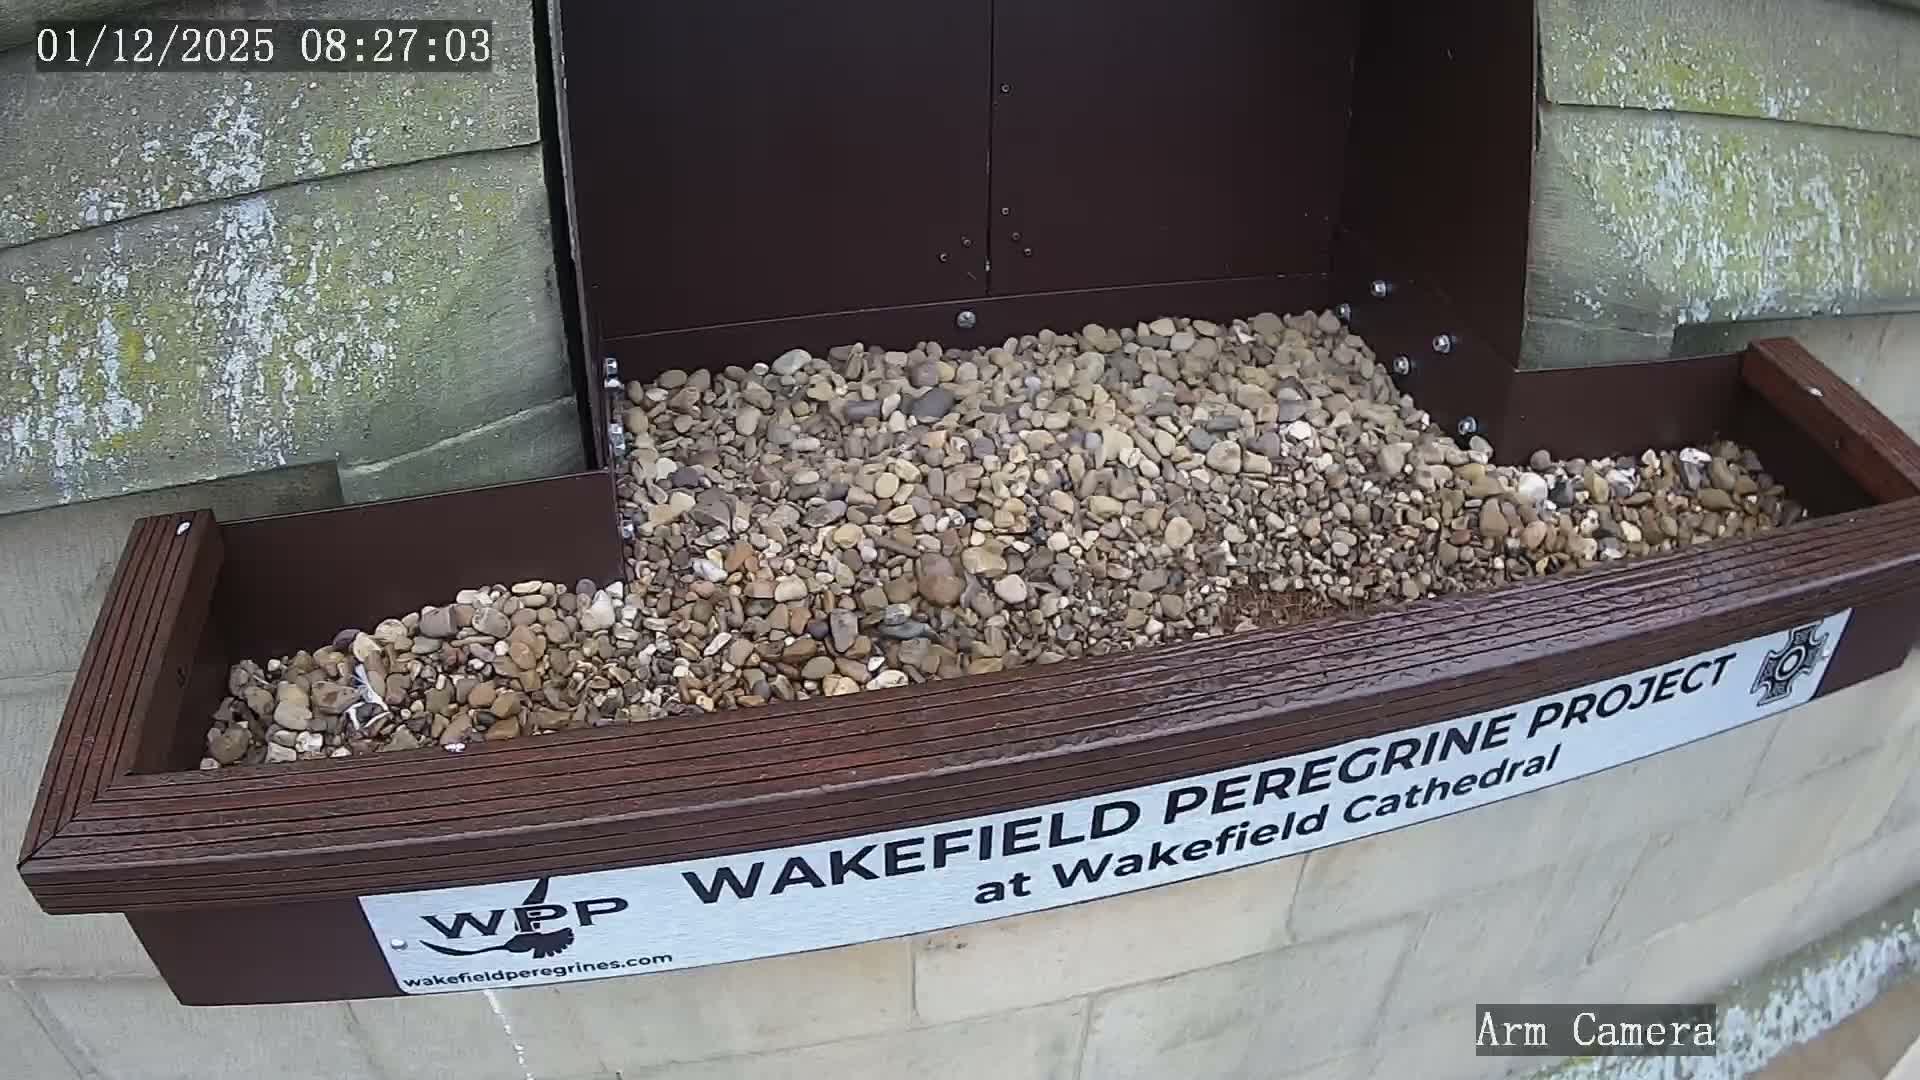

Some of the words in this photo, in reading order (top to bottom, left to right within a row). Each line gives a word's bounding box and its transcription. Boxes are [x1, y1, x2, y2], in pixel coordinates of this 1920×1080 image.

[684, 799, 1140, 905] WAKEFIELD
[1163, 714, 1517, 825] PEREGRINE
[1526, 653, 1737, 740] PROJECT
[974, 871, 1031, 905] at
[1052, 804, 1326, 885] Wakefield
[1342, 744, 1562, 823] Cathedral
[420, 896, 629, 940] WPP
[403, 953, 673, 988] wakefieldperegrines.com
